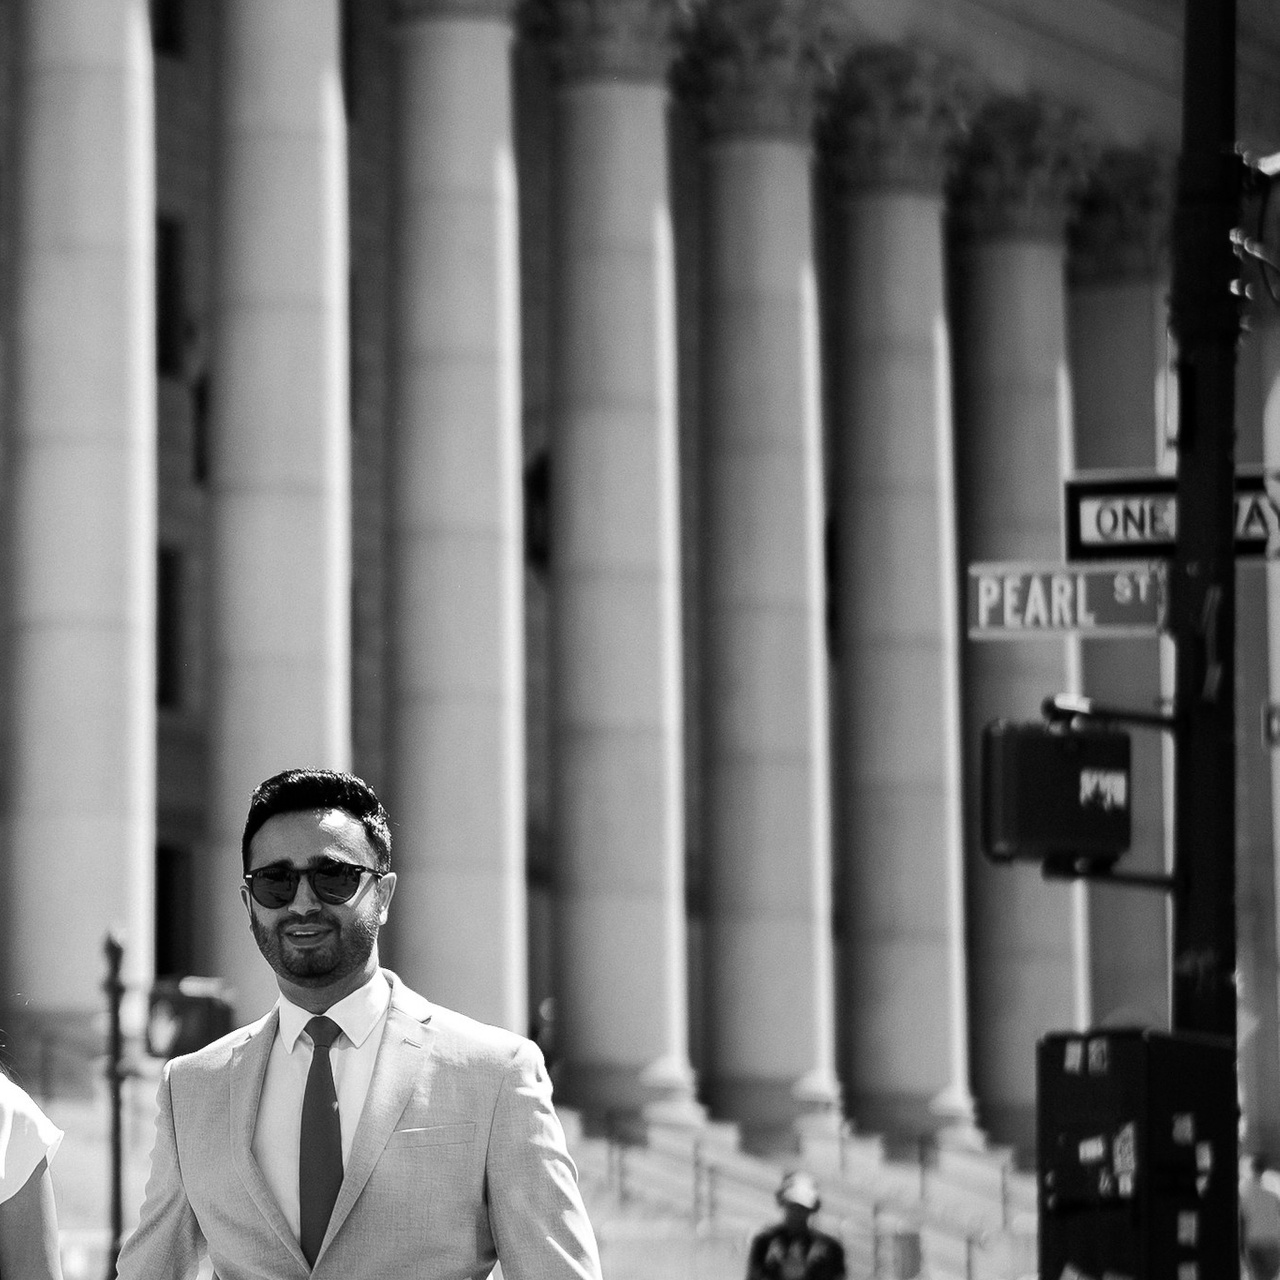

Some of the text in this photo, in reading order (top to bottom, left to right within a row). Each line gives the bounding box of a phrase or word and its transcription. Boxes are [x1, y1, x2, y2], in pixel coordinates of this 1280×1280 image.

[1096, 501, 1169, 539] ONE
[978, 573, 1151, 628] PEARL ST
